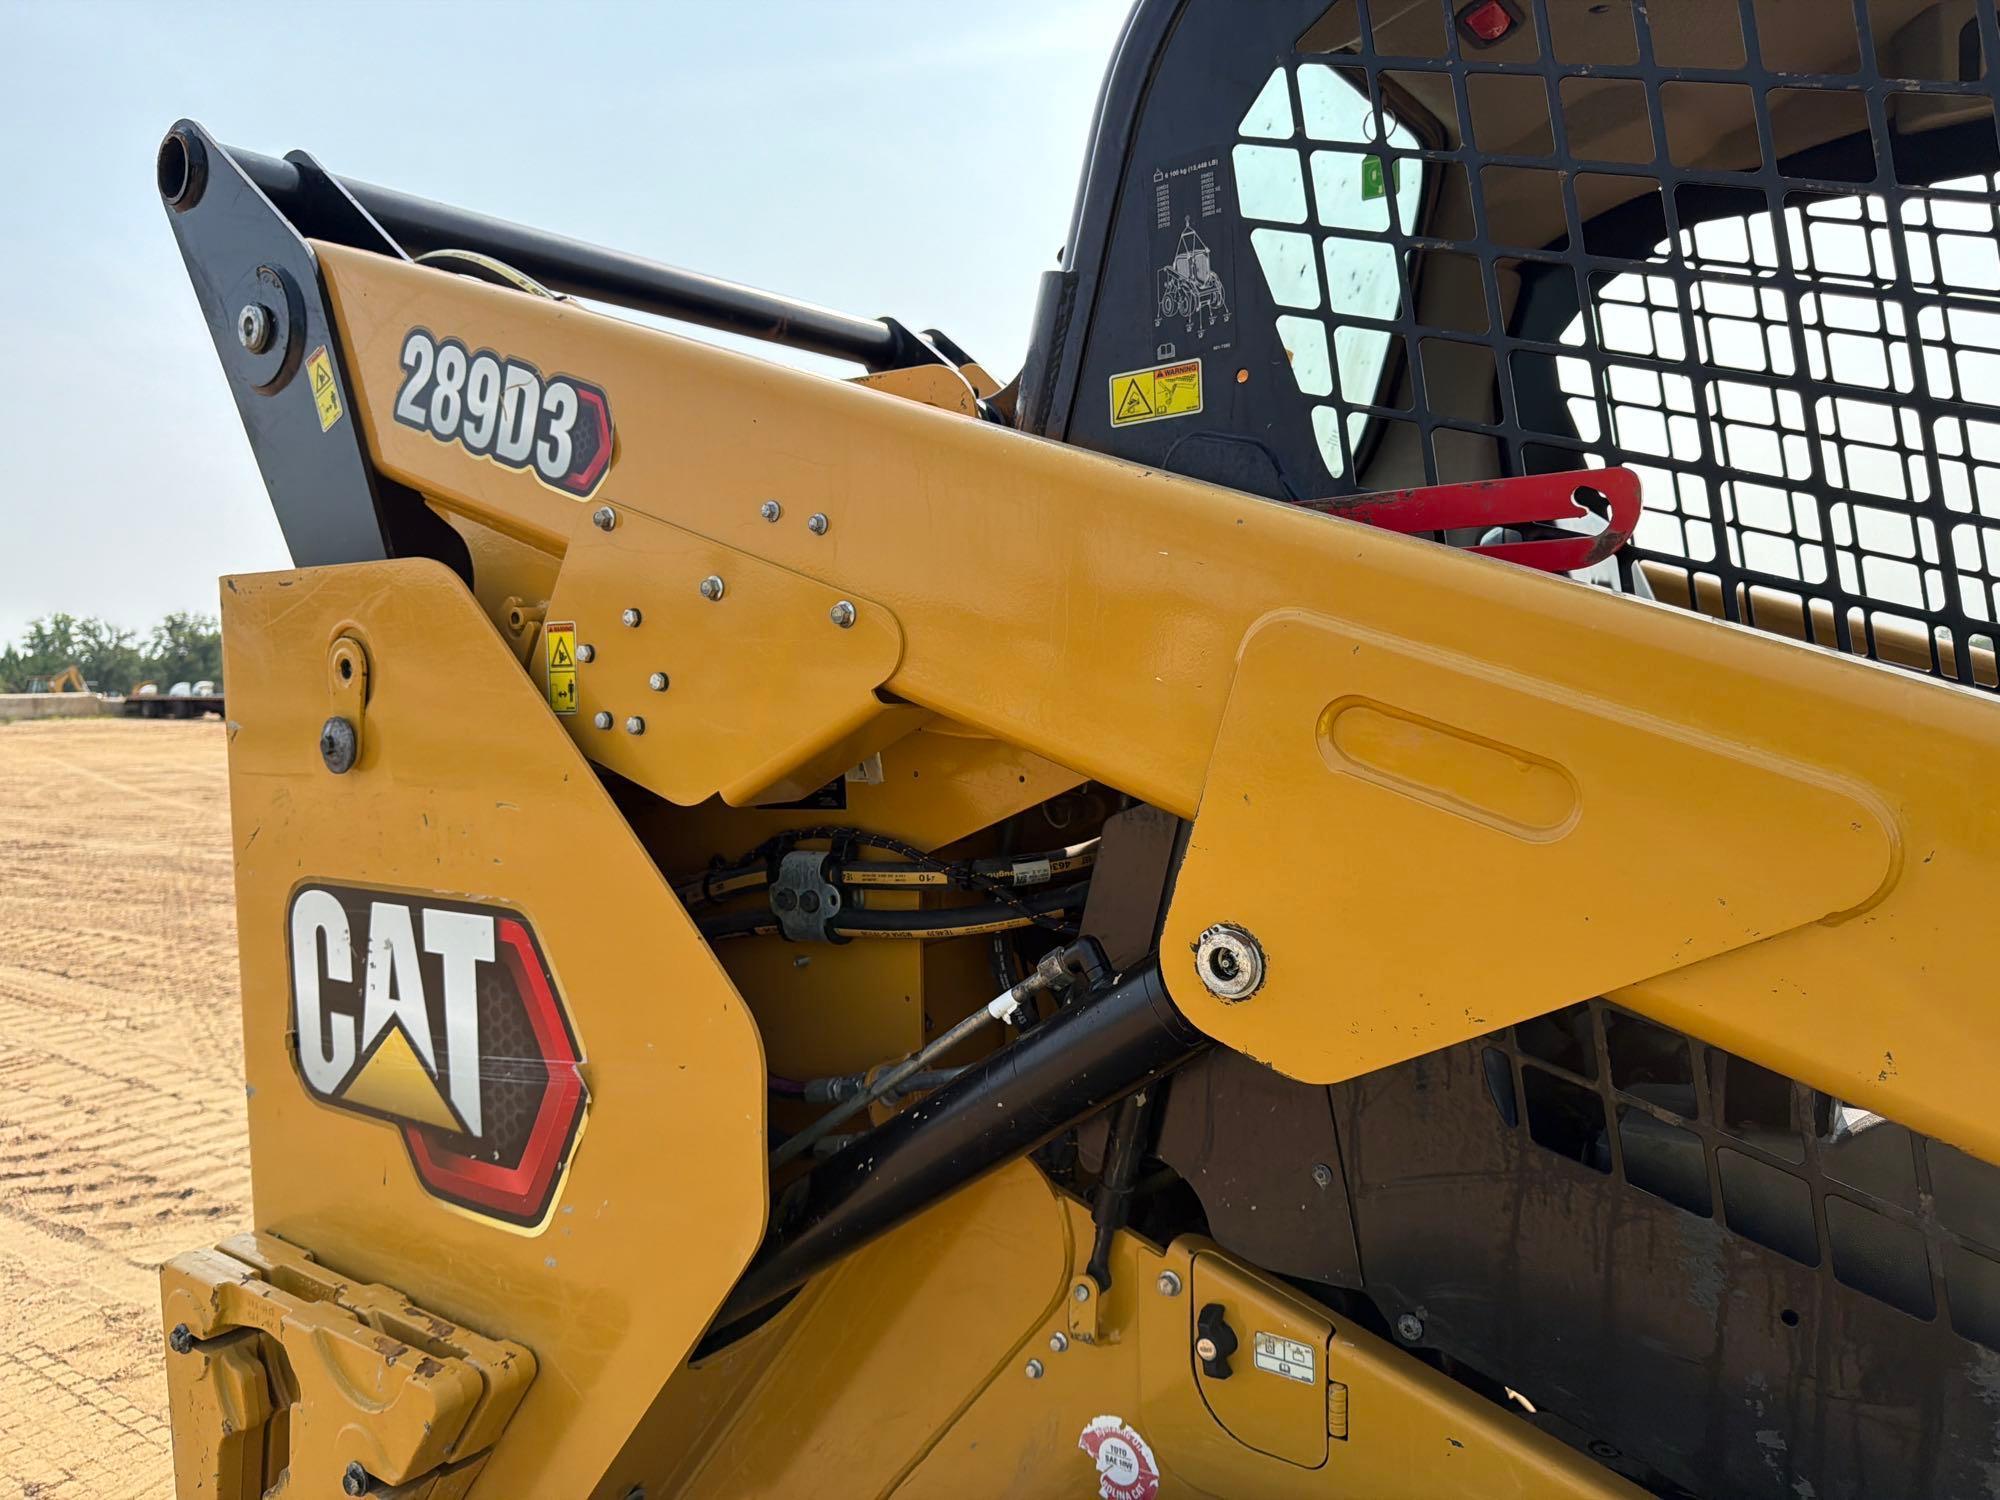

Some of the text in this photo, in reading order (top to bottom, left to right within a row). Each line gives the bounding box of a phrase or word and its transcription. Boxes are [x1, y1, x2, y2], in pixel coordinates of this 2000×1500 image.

[397, 335, 578, 478] 289D3
[1165, 365, 1196, 376] WARNING
[292, 889, 496, 1138] CAT
[1131, 1483, 1145, 1500] CAT
